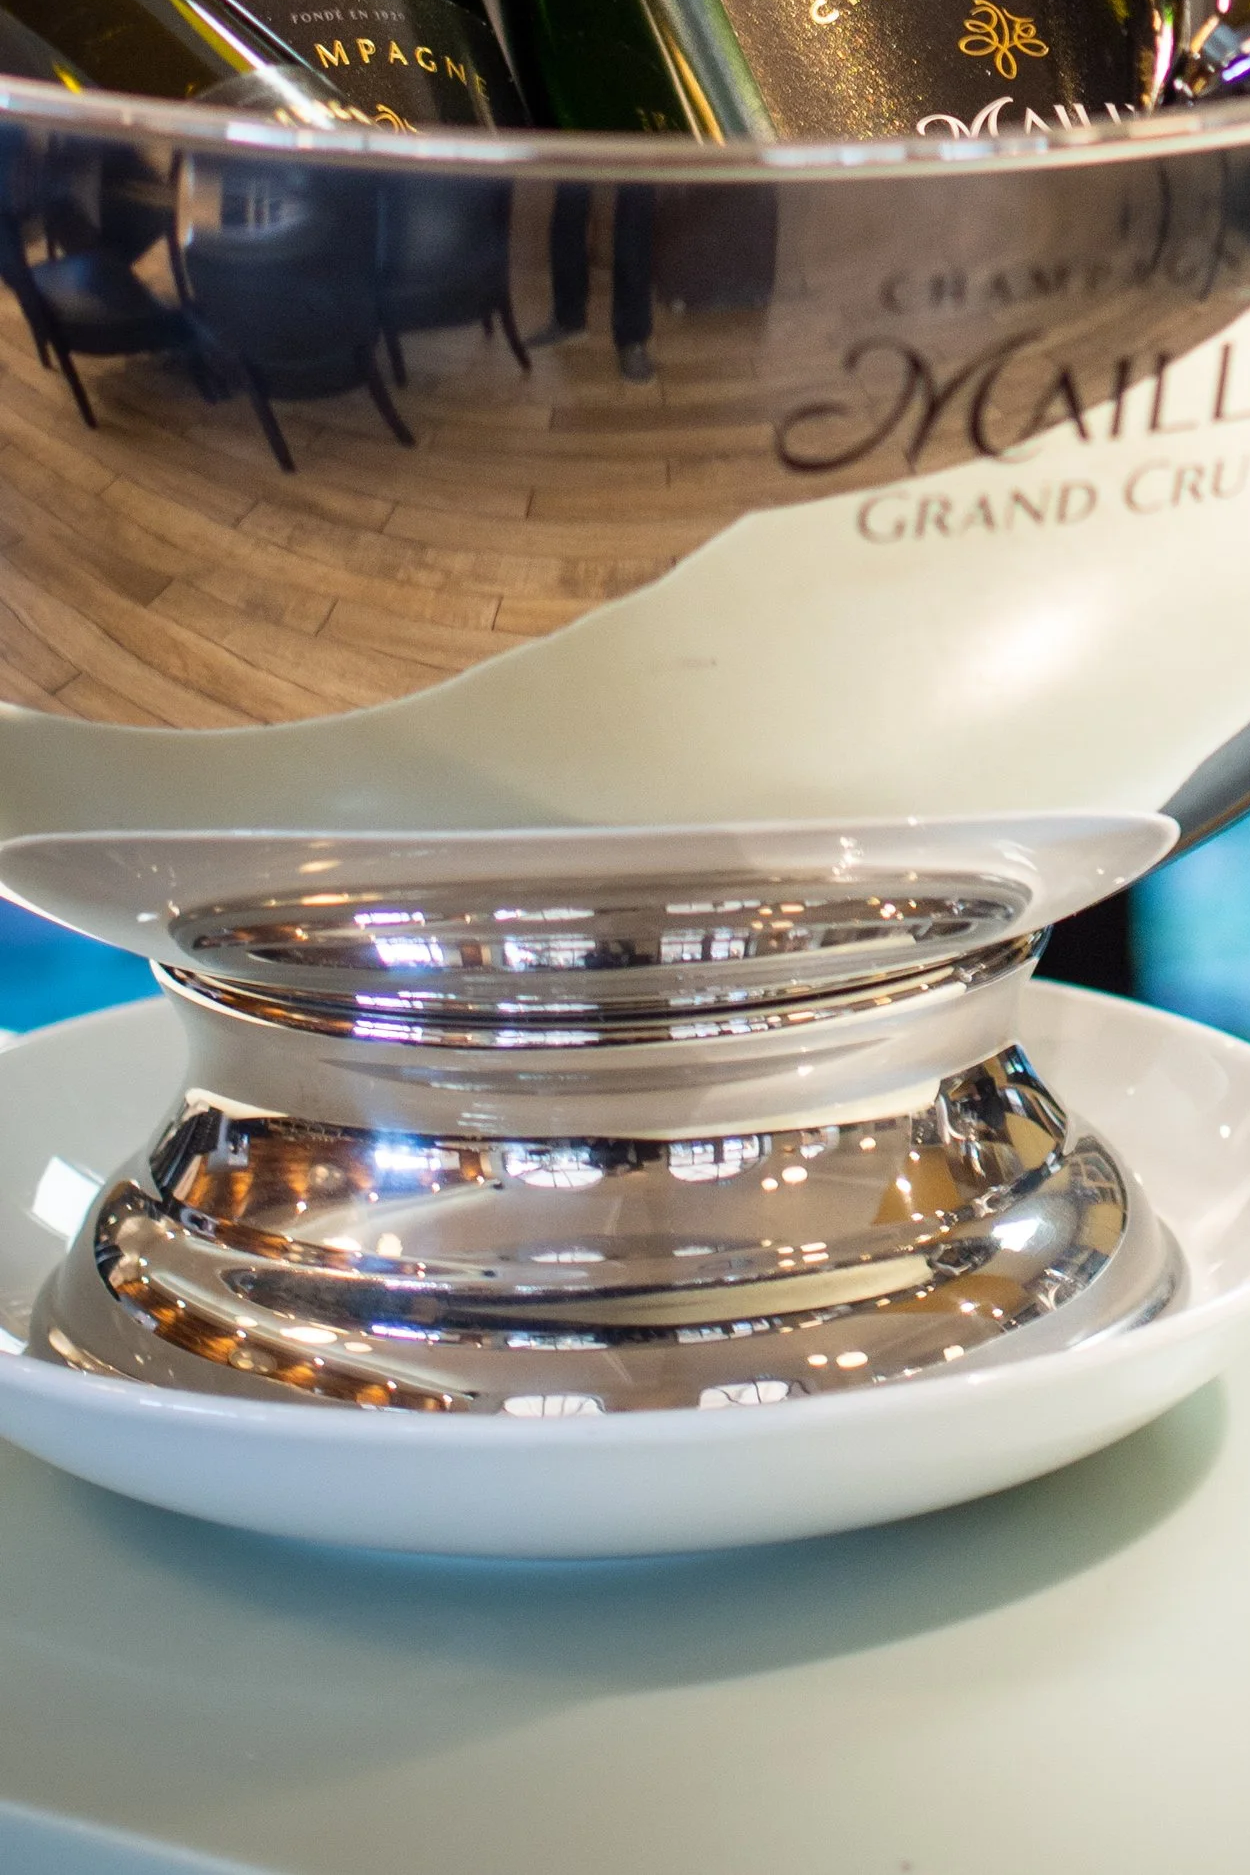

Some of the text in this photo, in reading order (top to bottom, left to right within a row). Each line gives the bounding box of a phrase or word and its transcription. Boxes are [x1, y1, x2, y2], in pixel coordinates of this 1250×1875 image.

[349, 9, 369, 21] EN
[313, 37, 490, 102] MPAGNE
[856, 453, 1250, 546] GRAND CRU
